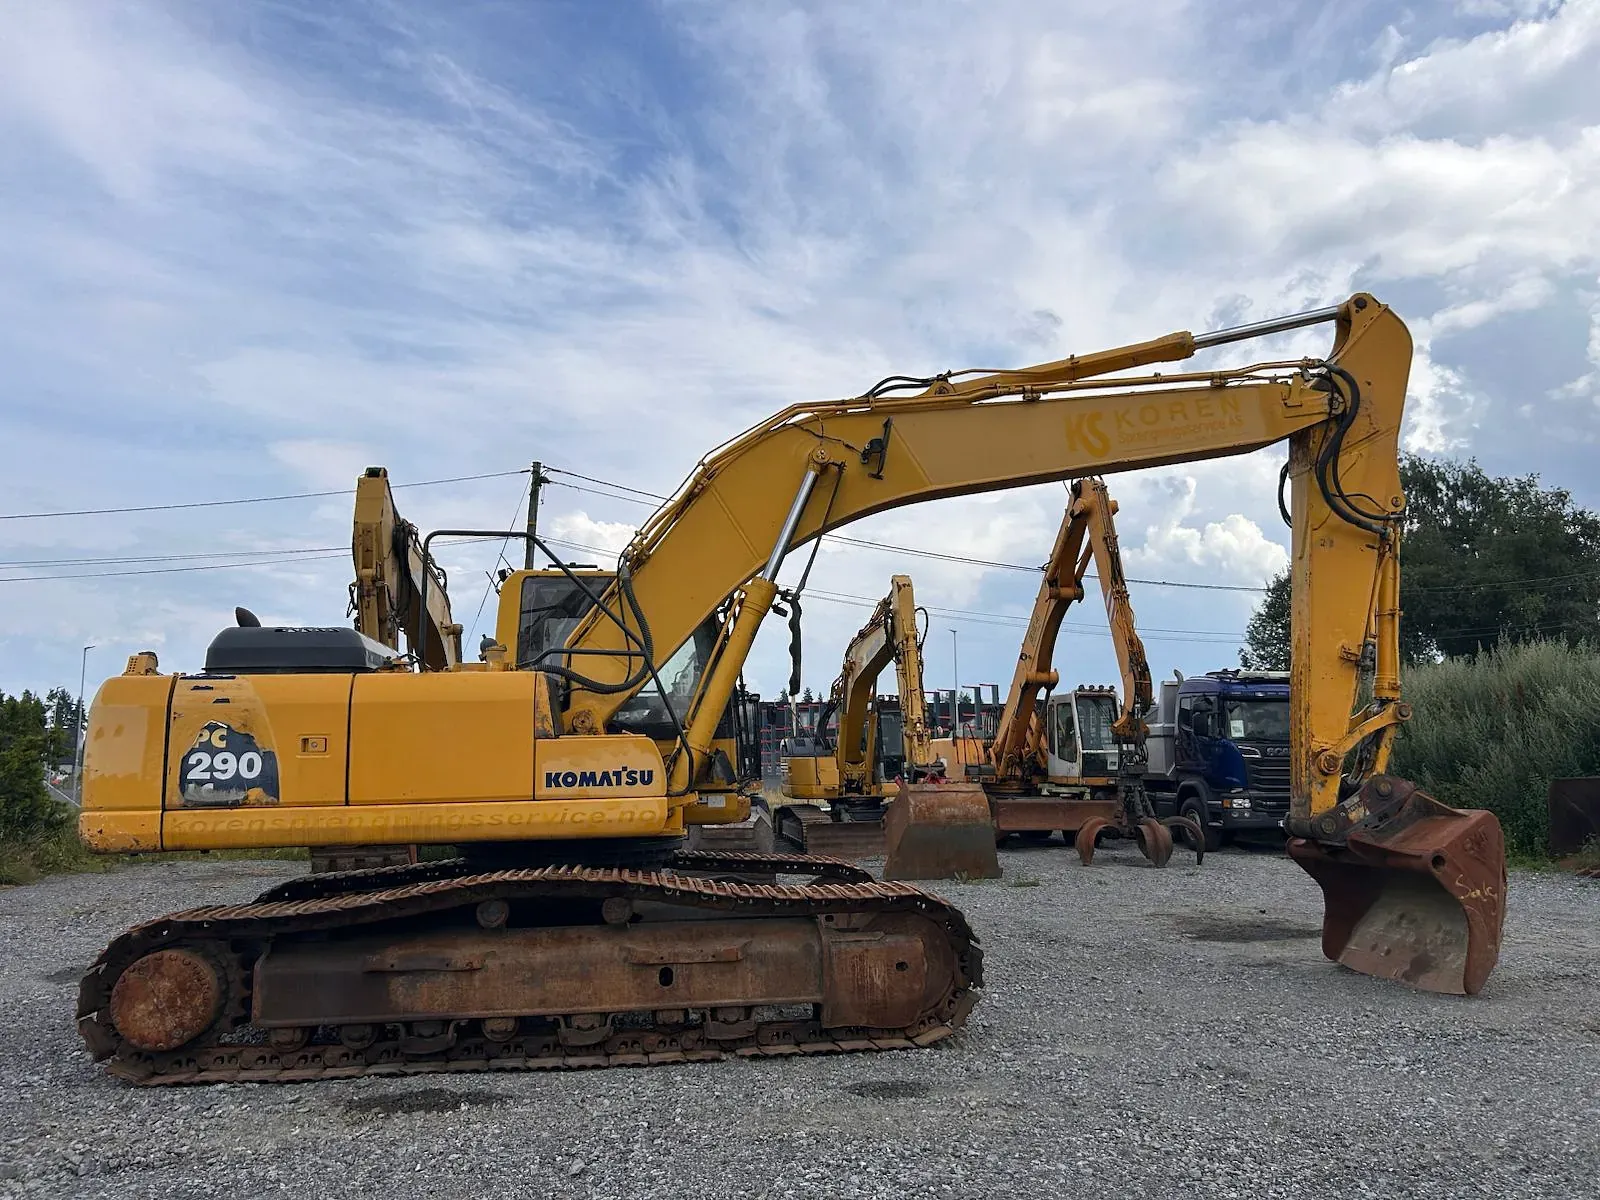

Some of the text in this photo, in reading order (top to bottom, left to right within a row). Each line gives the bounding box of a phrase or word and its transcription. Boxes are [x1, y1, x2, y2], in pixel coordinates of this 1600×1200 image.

[1113, 394, 1241, 428] KOREN
[1064, 411, 1112, 458] KS
[191, 728, 228, 748] PC
[186, 751, 262, 780] 290
[545, 766, 654, 788] KOMATSU
